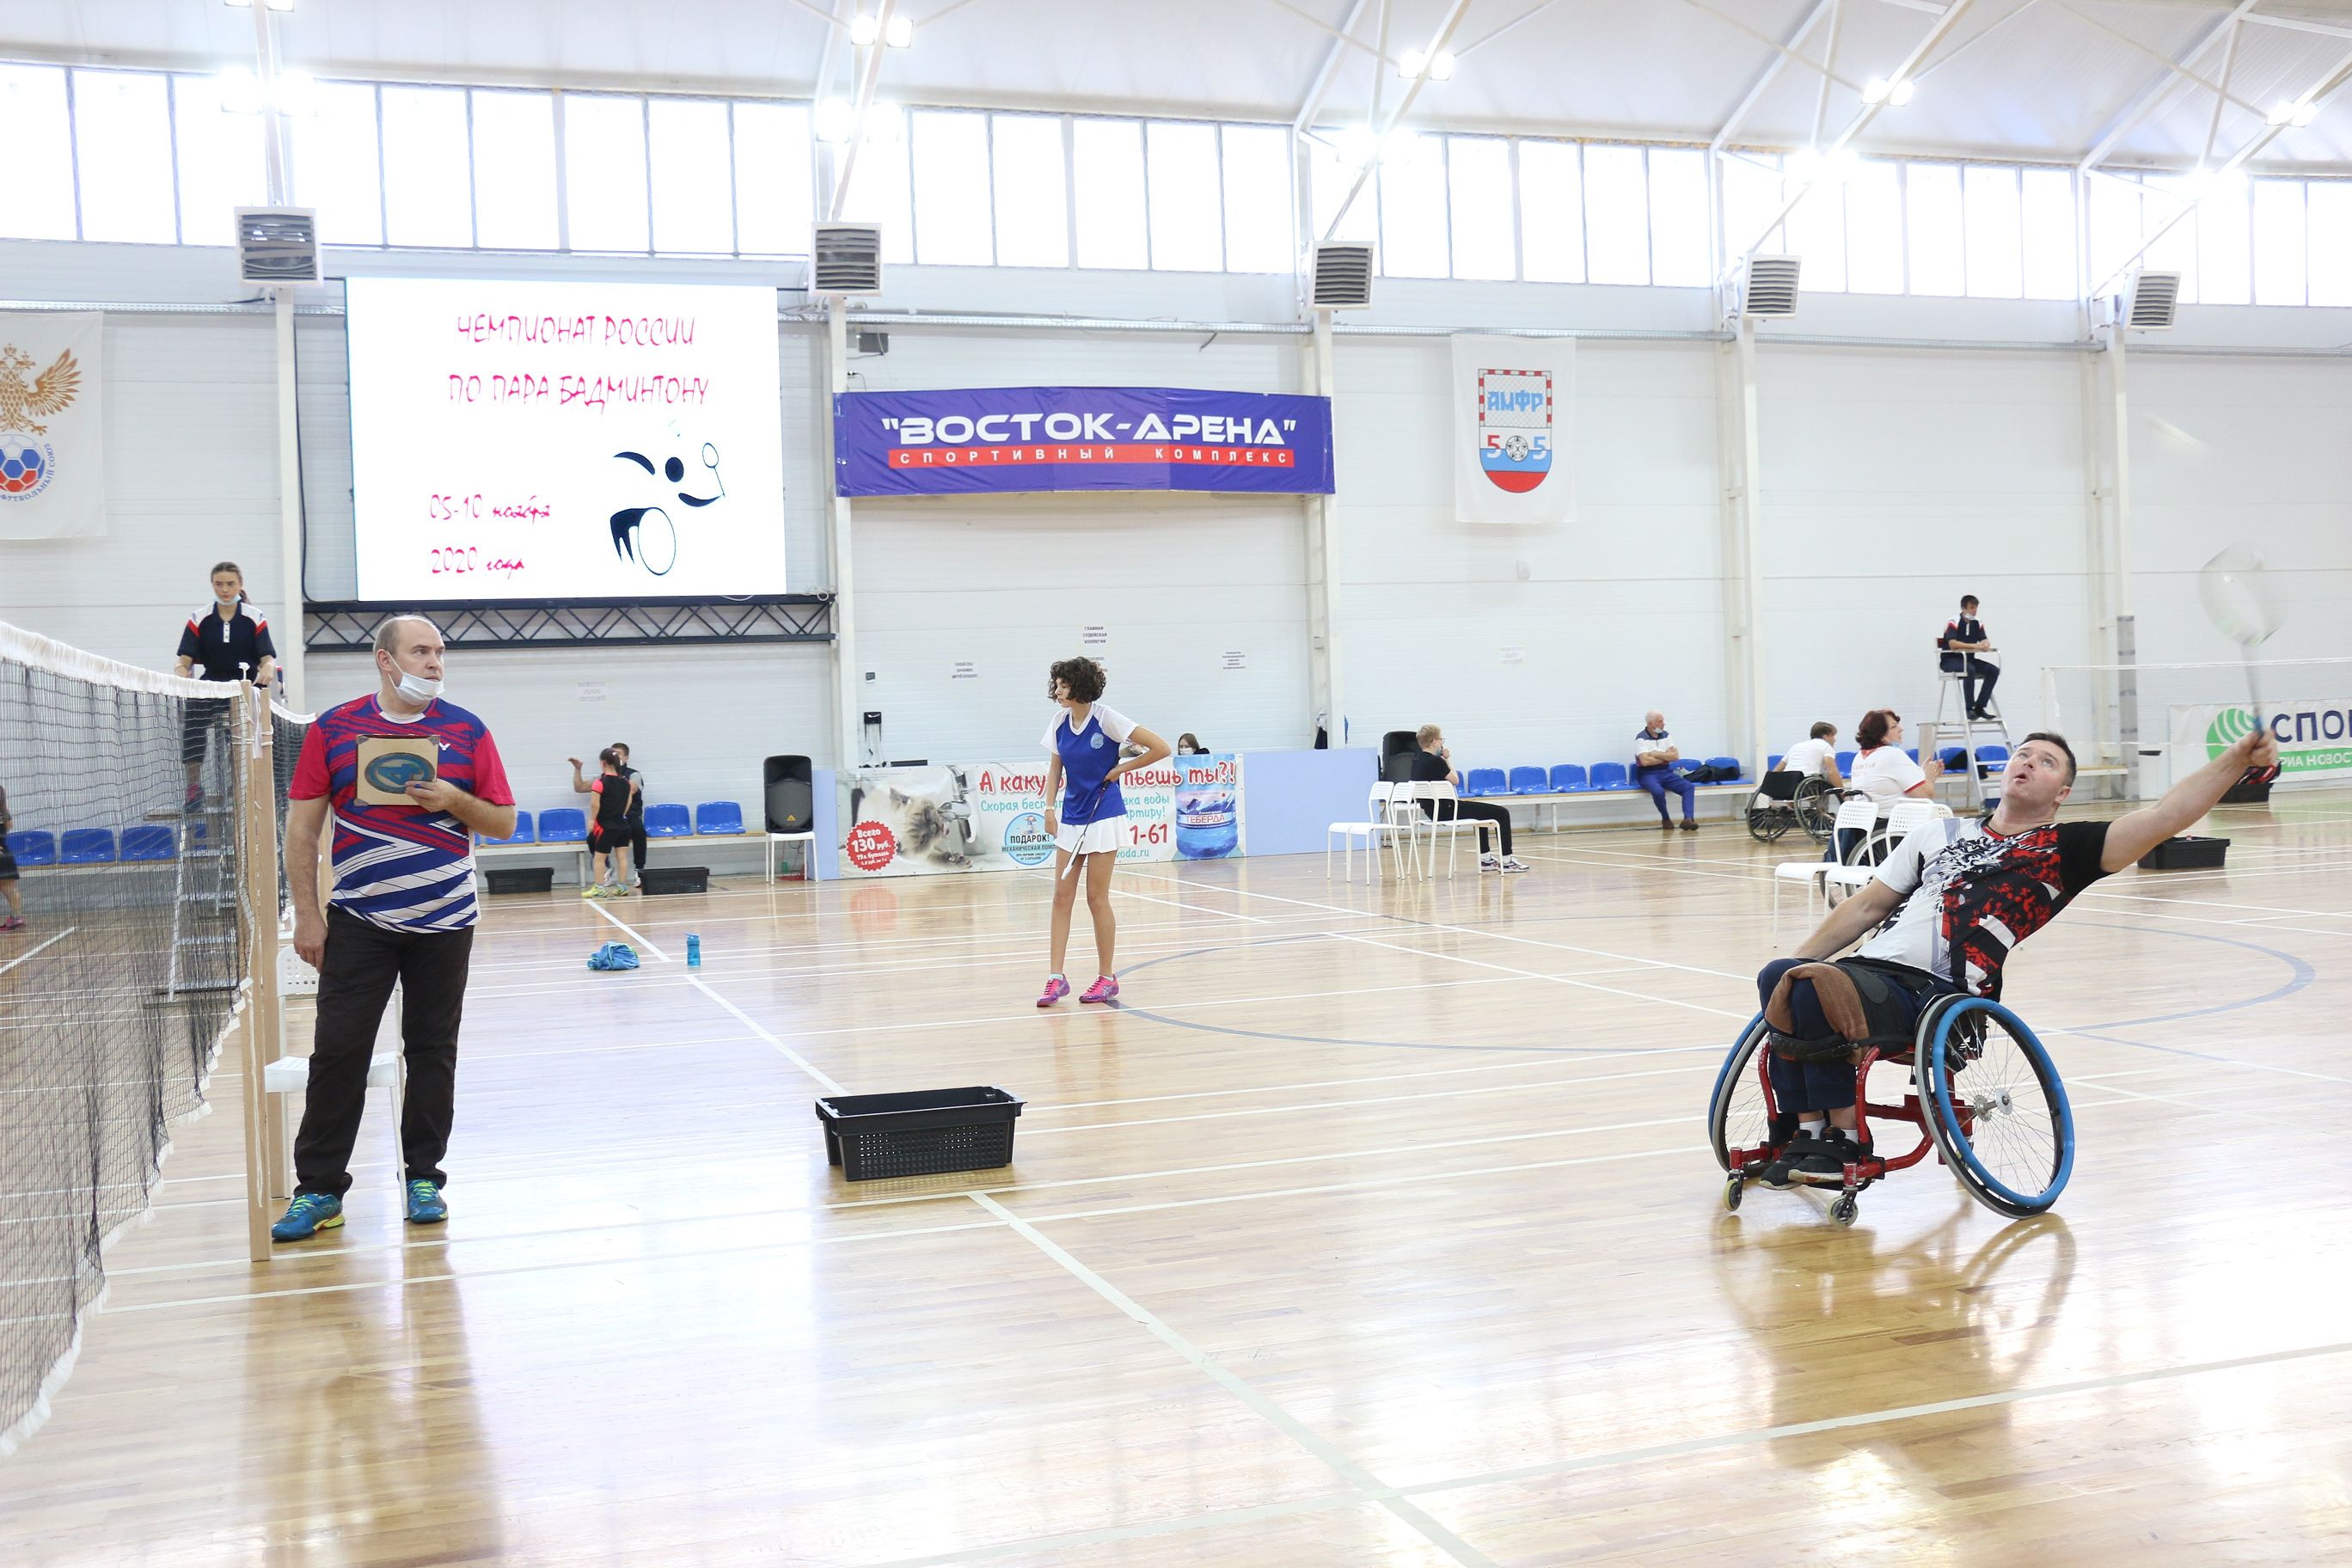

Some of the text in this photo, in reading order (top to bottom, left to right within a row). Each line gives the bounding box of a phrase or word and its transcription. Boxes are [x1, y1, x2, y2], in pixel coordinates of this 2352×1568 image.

[457, 314, 695, 346] ЧЕМПИОНАТ РОССИИ
[449, 373, 709, 415] ПО ПАРА БАДМИНТОНУ
[881, 413, 1296, 445] "ВОСТОК-АРЕНА"
[900, 446, 1286, 463] СПОРТИВНЫЙ КОМПЛЕКС
[1486, 435, 1502, 459] 5
[1533, 436, 1547, 461] 5
[430, 493, 482, 520] 05-10
[431, 546, 524, 580] 2020 года
[2270, 710, 2352, 743] СПО
[2306, 752, 2352, 766] НОВОС
[979, 770, 994, 793] А
[1124, 769, 1182, 787] пьешь
[1189, 762, 1236, 784] ты?!
[981, 799, 1019, 812] Скорая
[1143, 792, 1170, 805] воды
[1126, 805, 1166, 820] ртиру!
[1185, 814, 1225, 824] ТЕБЕРДА
[856, 829, 881, 838] Всего
[1010, 834, 1050, 844] ПОДАРОК!
[1129, 824, 1167, 845] 1-61
[851, 837, 891, 853] 130 руб.
